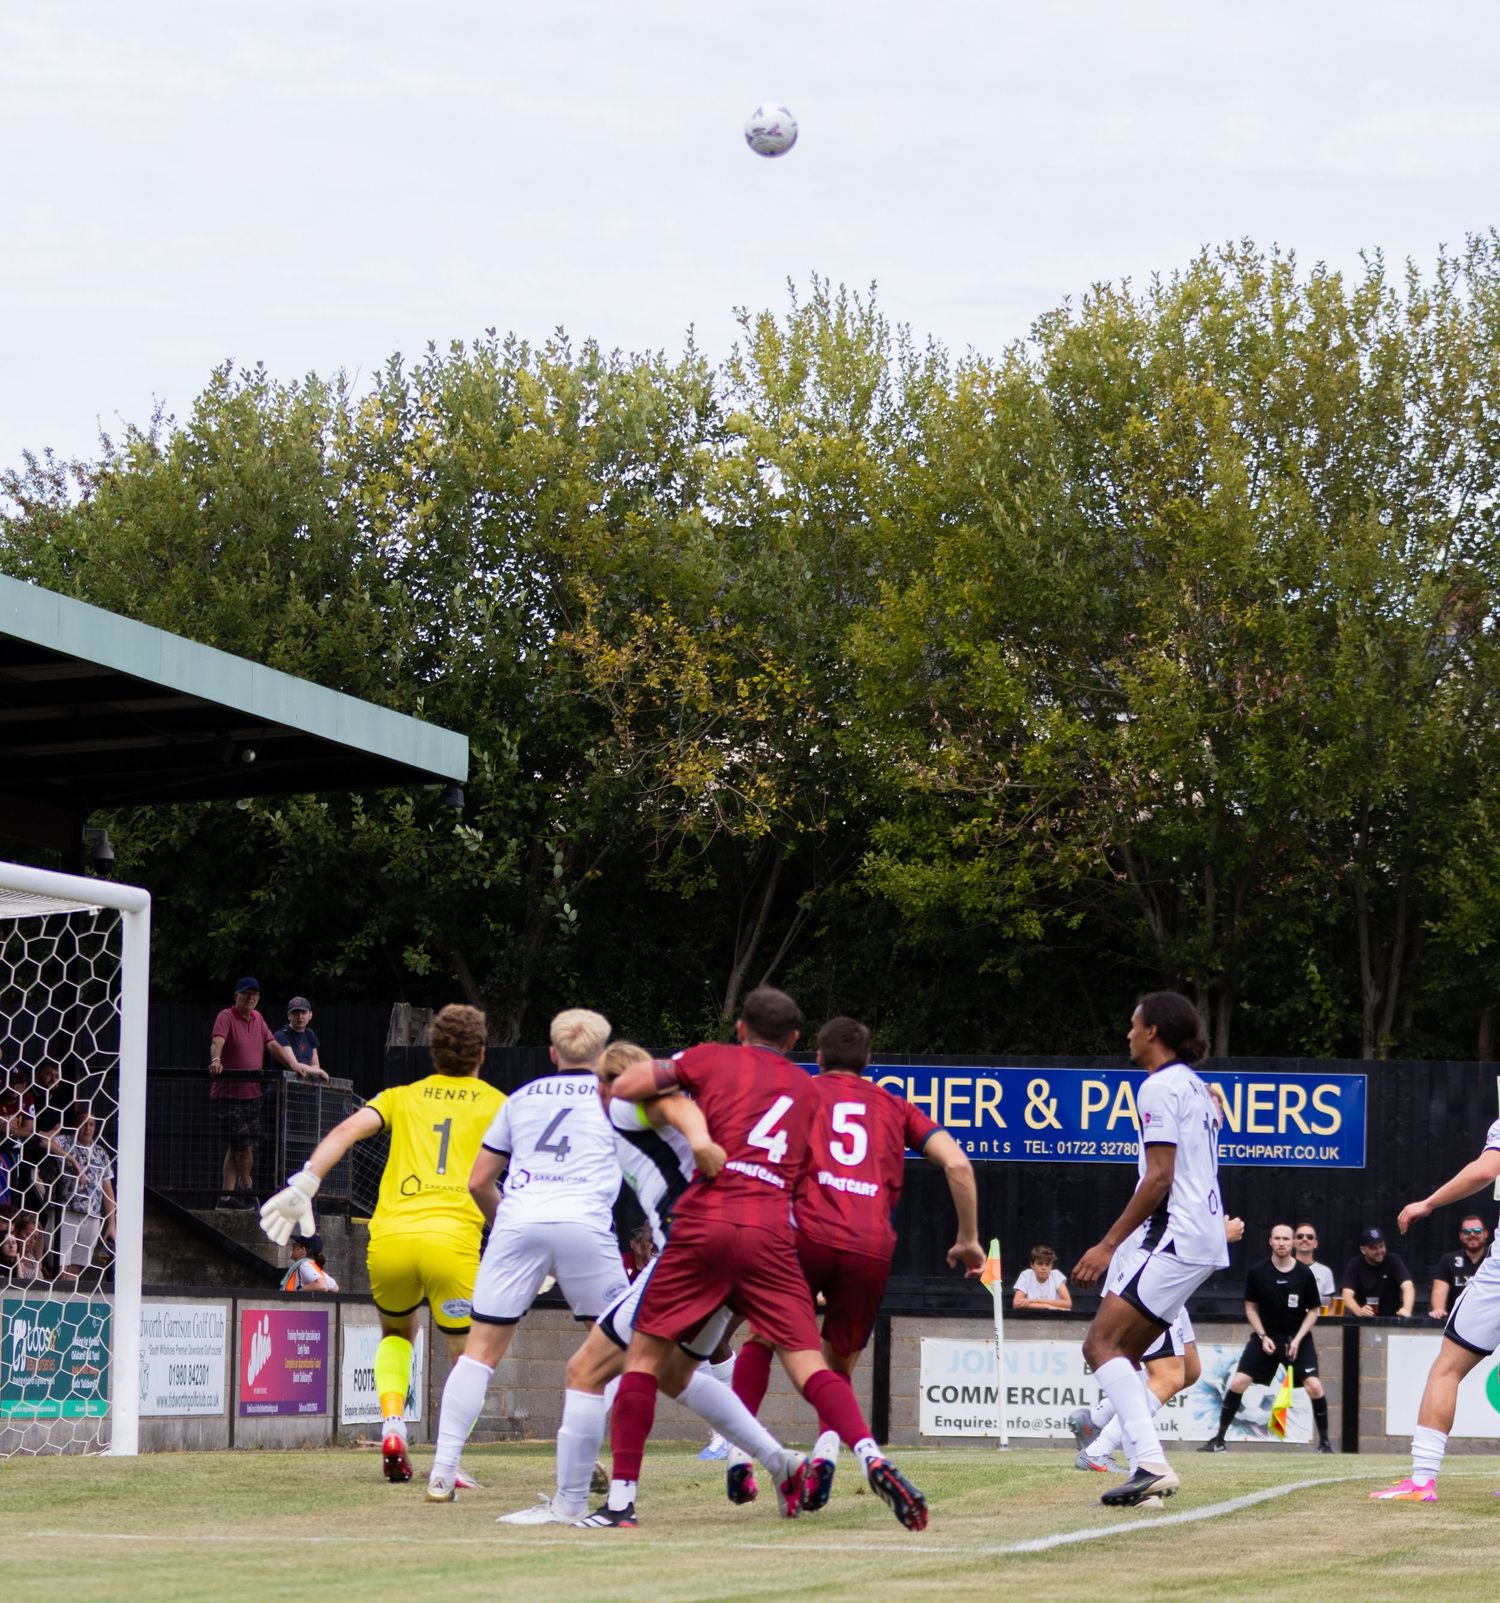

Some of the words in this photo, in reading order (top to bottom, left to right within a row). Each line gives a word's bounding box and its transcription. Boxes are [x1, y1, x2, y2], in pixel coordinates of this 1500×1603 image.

[423, 1087, 481, 1102] HENRY
[1024, 1078, 1063, 1130] &
[1081, 1080, 1342, 1136] PANERS
[534, 1107, 573, 1163] 4
[747, 1095, 794, 1164] 4
[829, 1102, 868, 1166] 5
[433, 1118, 452, 1175] 1
[1024, 1140, 1053, 1154] TEL:
[1057, 1141, 1096, 1155] 01722
[1100, 1142, 1140, 1156] 32780
[424, 1182, 470, 1194] SAKAN.CO
[1454, 1256, 1464, 1268] 3
[163, 1311, 192, 1338] Garrison
[193, 1312, 208, 1339] Golf
[208, 1312, 224, 1339] Club
[946, 1349, 1019, 1375] JOIN
[1028, 1351, 1068, 1376] US
[353, 1368, 377, 1392] FOOTB
[926, 1385, 1091, 1406] COMMERCIAL
[935, 1415, 997, 1430] Enquire:
